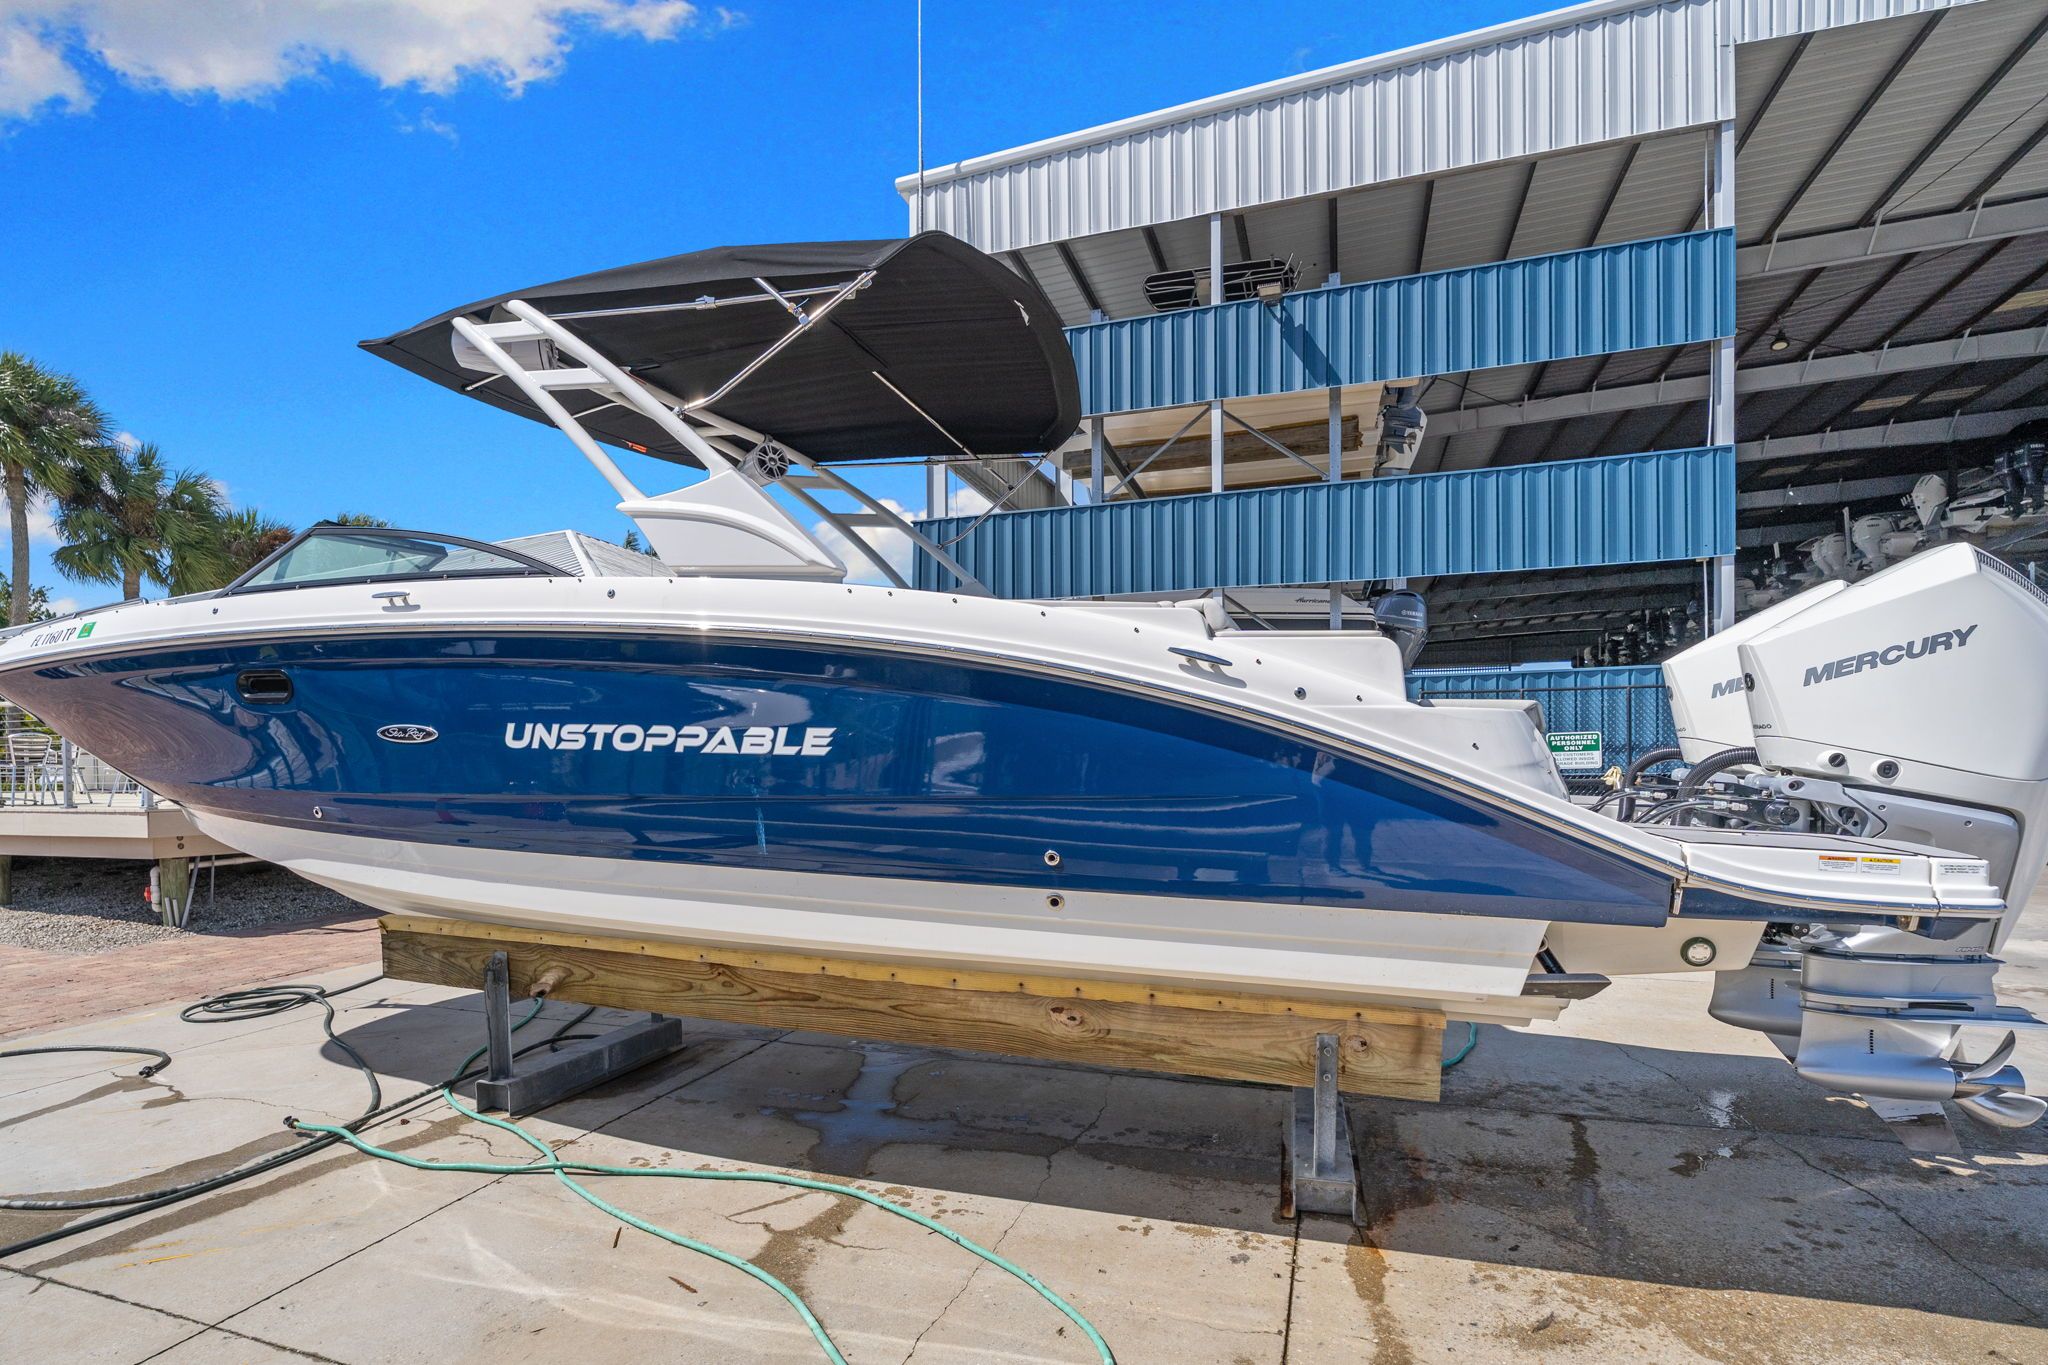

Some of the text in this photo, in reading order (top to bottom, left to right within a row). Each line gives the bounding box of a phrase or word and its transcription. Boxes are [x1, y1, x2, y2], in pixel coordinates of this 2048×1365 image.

[30, 634, 43, 647] FL
[42, 630, 63, 645] 1160
[62, 627, 77, 641] TP
[1803, 624, 1978, 687] MERCURY
[385, 727, 426, 740] Sea Ray
[505, 723, 837, 755] UNSTOPPABLE
